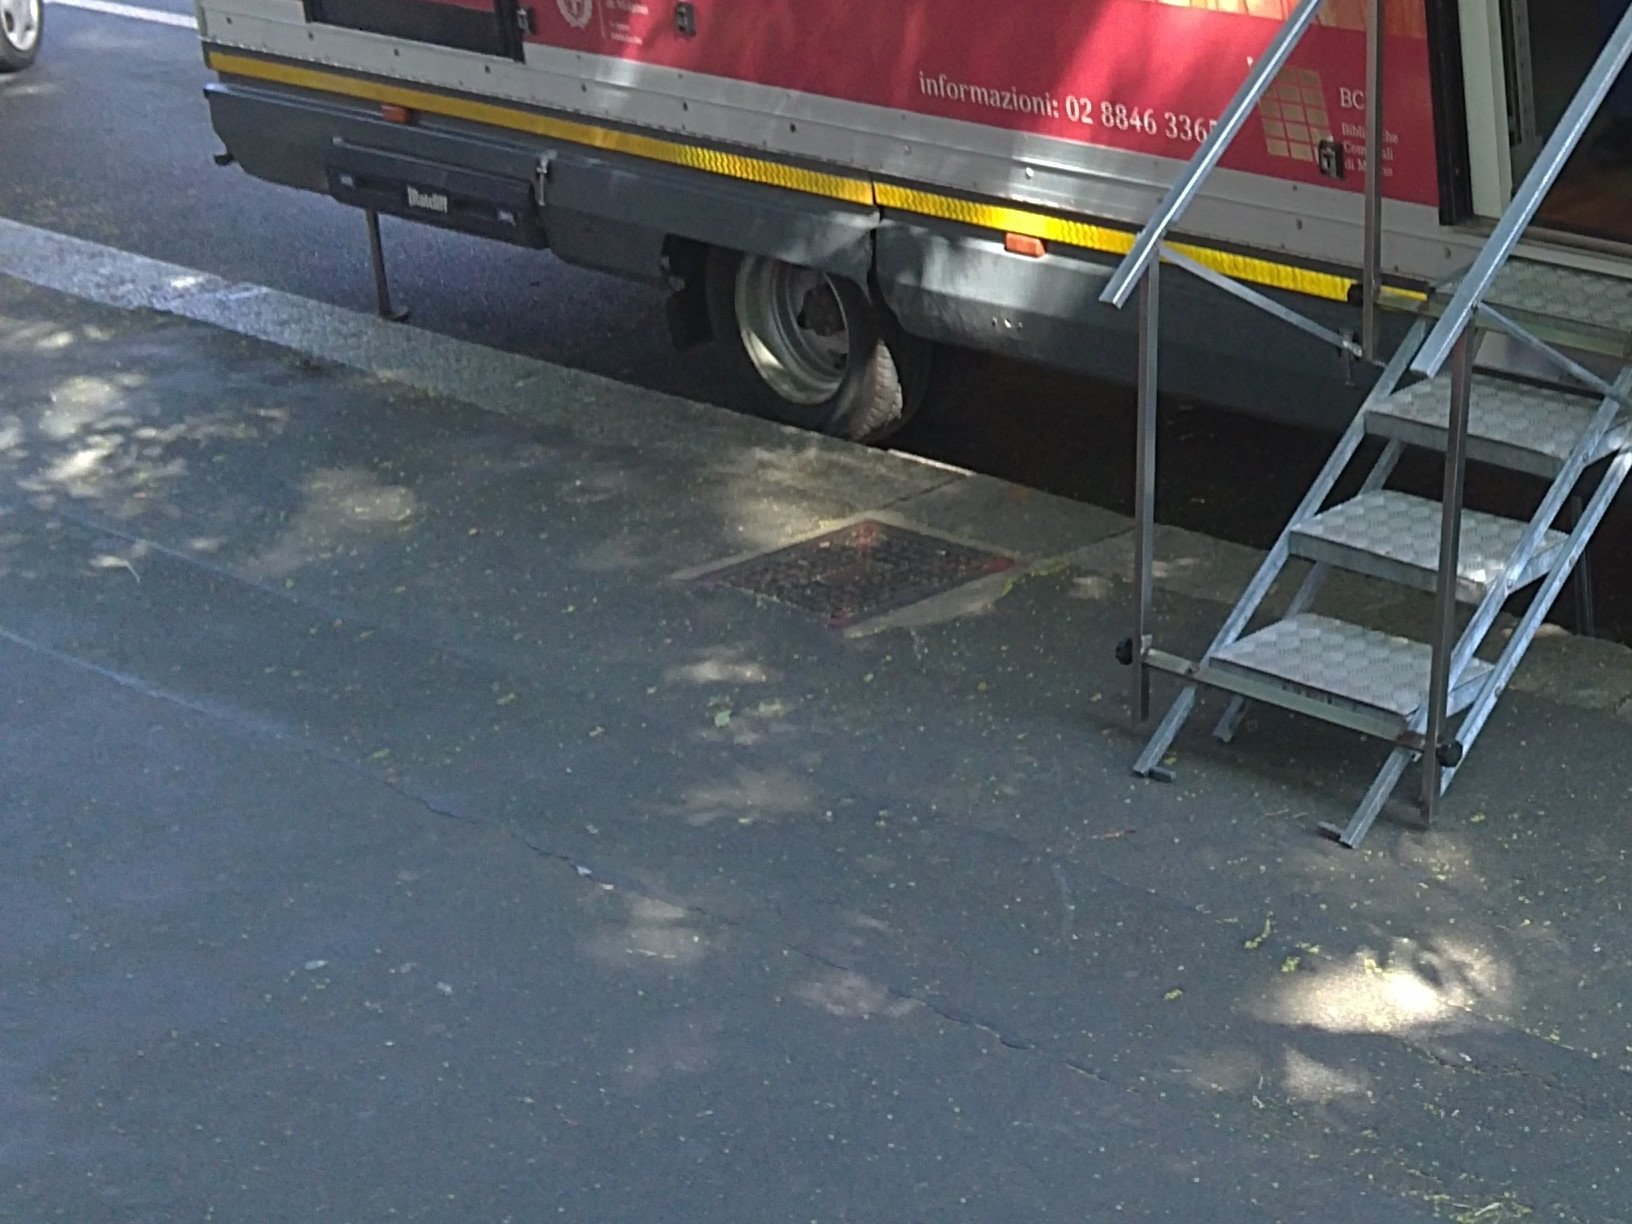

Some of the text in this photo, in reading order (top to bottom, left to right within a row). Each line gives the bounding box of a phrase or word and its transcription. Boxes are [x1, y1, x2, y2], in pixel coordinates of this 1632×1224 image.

[919, 71, 1059, 118] informazioni:
[1065, 95, 1094, 124] 02
[1101, 101, 1157, 136] 8846
